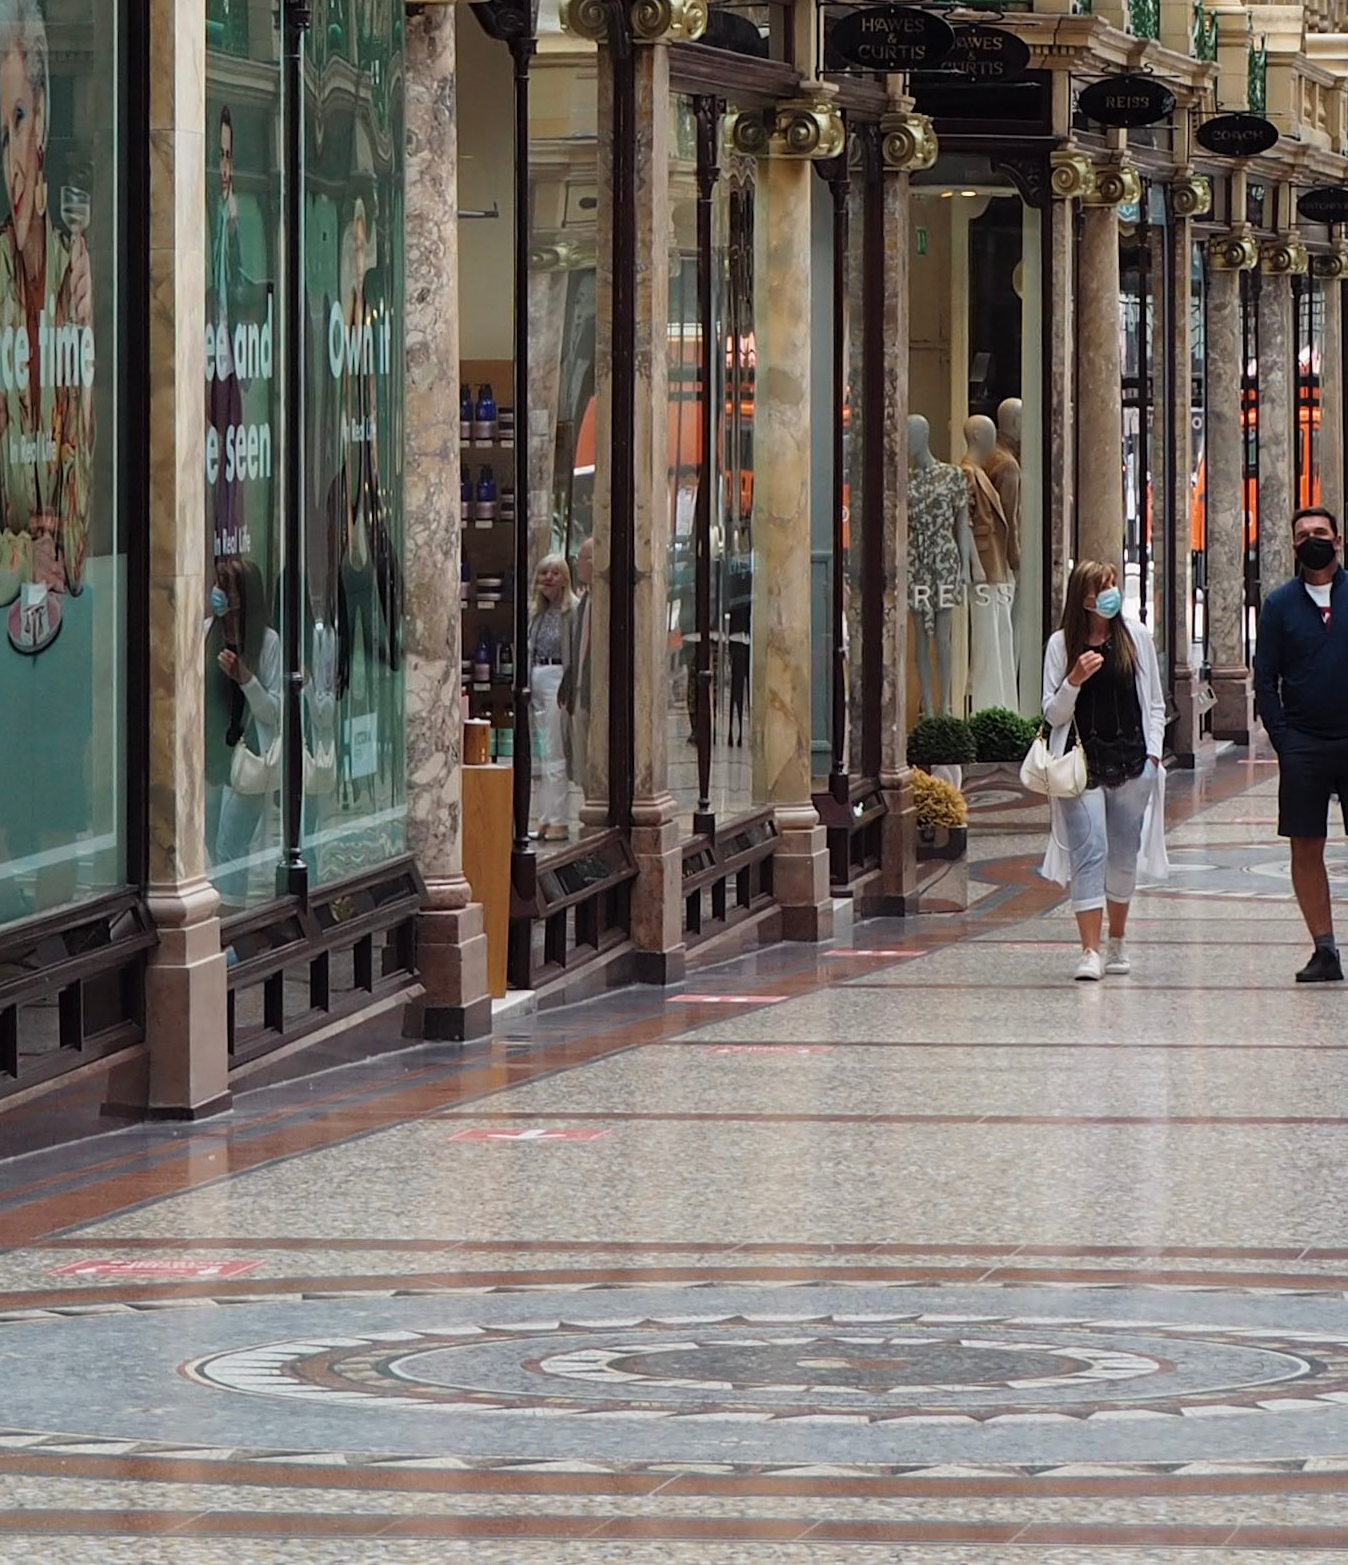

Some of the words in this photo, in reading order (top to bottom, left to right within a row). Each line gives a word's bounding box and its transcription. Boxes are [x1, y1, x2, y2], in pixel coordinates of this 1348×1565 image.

[861, 18, 925, 32] HAWES
[887, 33, 897, 44] &
[952, 36, 1003, 50] AWES
[858, 45, 926, 60] CURTIS
[967, 51, 977, 61] &
[1105, 96, 1150, 109] REISS
[38, 293, 95, 388] time
[205, 321, 230, 382] ee
[234, 293, 273, 380] and
[329, 300, 373, 379] Own
[379, 300, 391, 375] it
[206, 424, 219, 484] e
[225, 422, 272, 482] seen
[214, 530, 222, 556] In
[222, 527, 237, 555] Real
[238, 524, 251, 553] Life
[914, 583, 1013, 608] REISS
